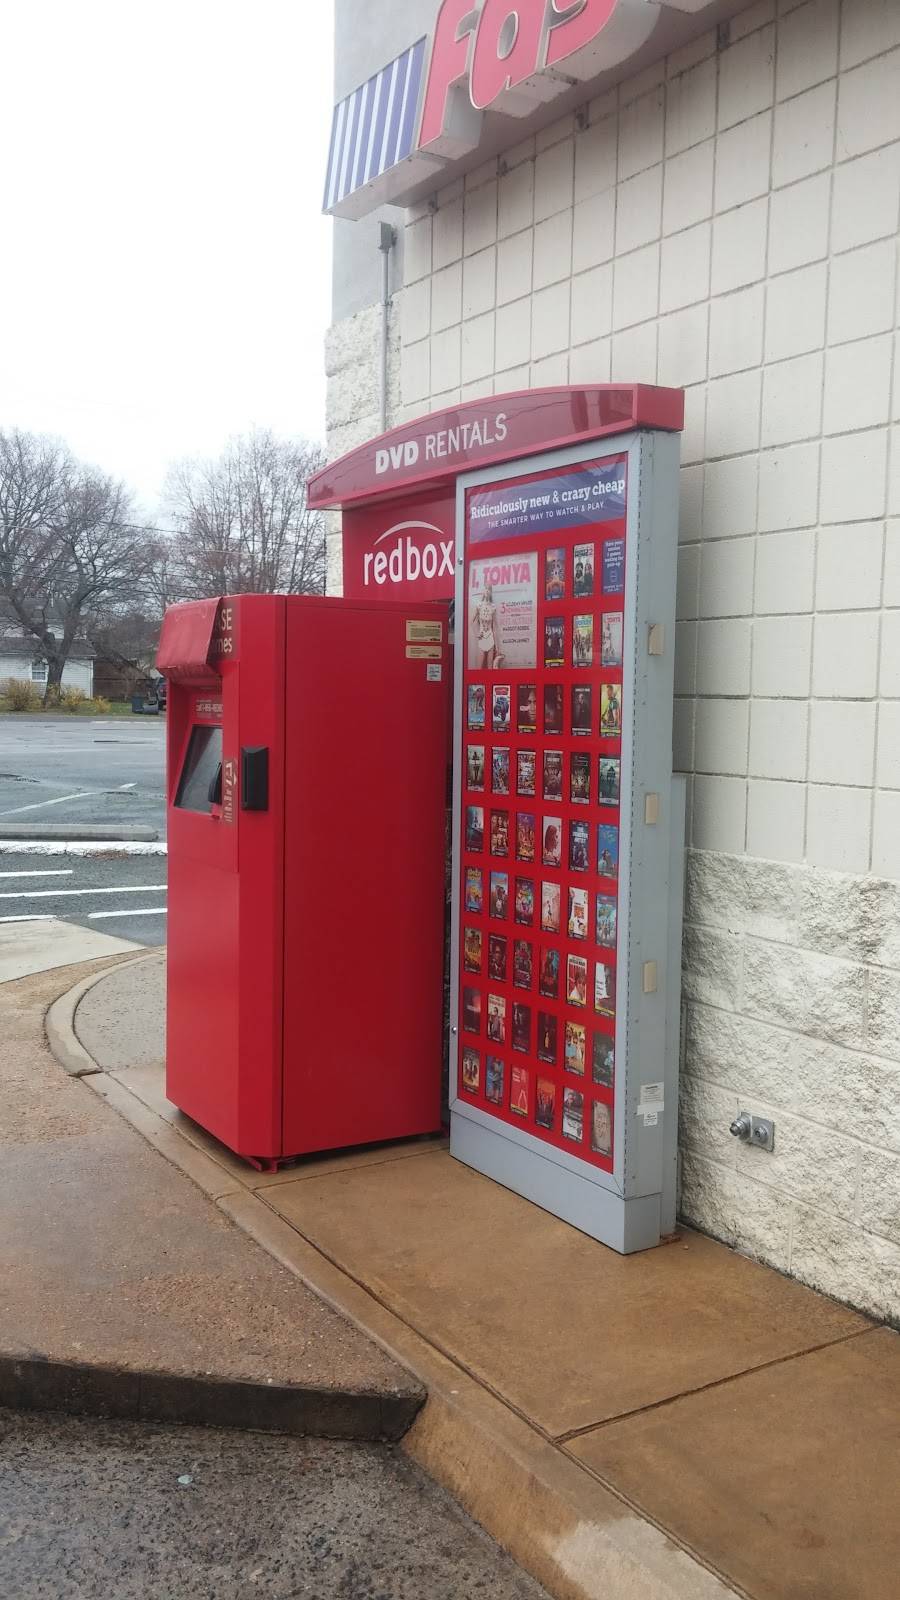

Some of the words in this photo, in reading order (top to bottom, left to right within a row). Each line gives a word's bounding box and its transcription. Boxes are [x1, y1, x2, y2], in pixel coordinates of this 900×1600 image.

[375, 440, 419, 474] DVD
[425, 413, 507, 461] RENTALS
[470, 497, 528, 520] Ridiculously
[530, 495, 550, 508] new
[552, 490, 559, 503] &
[561, 486, 591, 501] crazy
[592, 479, 625, 495] cheap
[488, 521, 499, 529] THE
[500, 515, 528, 526] SMARTER
[530, 511, 543, 521] WAY
[546, 510, 553, 518] TO
[556, 505, 579, 517] WATCH
[587, 501, 604, 511] PLAY
[363, 536, 455, 585] redbox
[483, 562, 531, 586] TONYA
